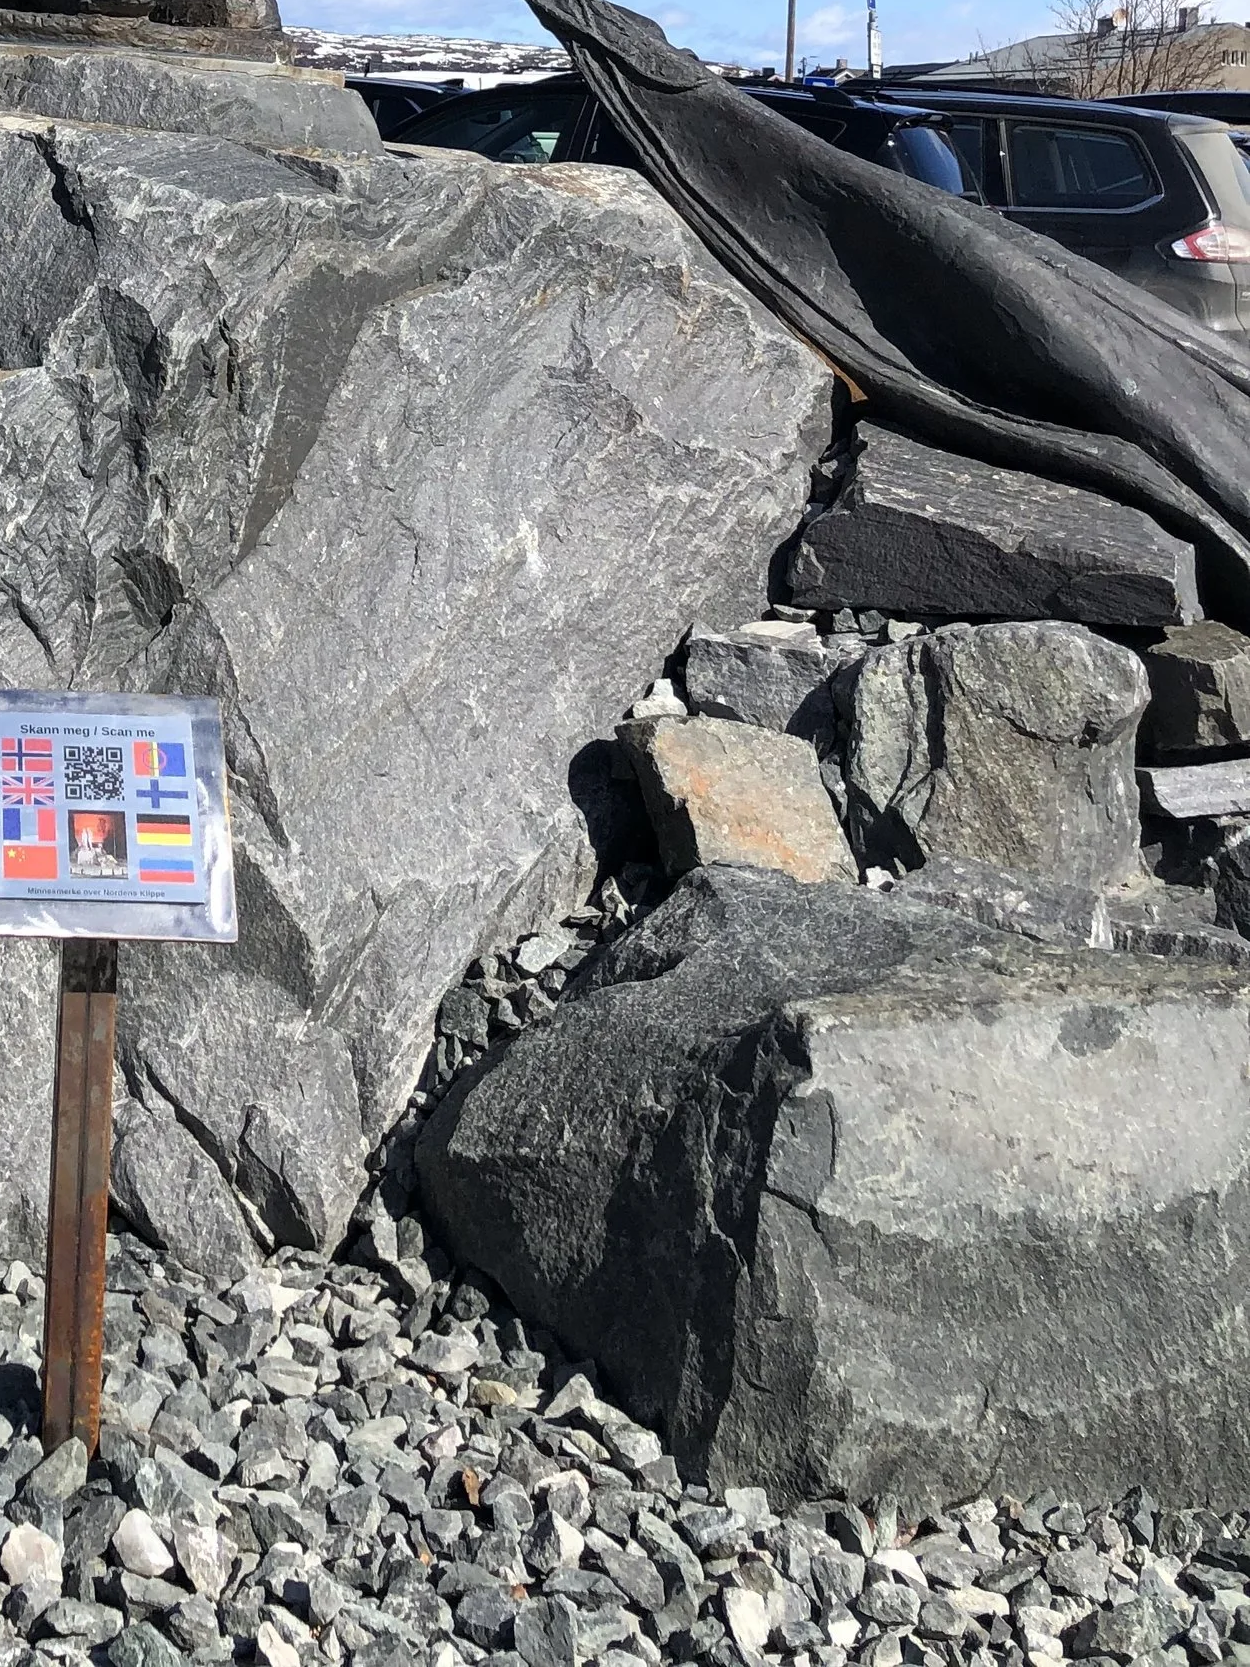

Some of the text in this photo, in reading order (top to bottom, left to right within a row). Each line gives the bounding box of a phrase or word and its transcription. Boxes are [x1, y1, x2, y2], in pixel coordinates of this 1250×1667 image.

[20, 724, 156, 738] Skann meg / Scan me
[139, 890, 166, 898] Klippe
